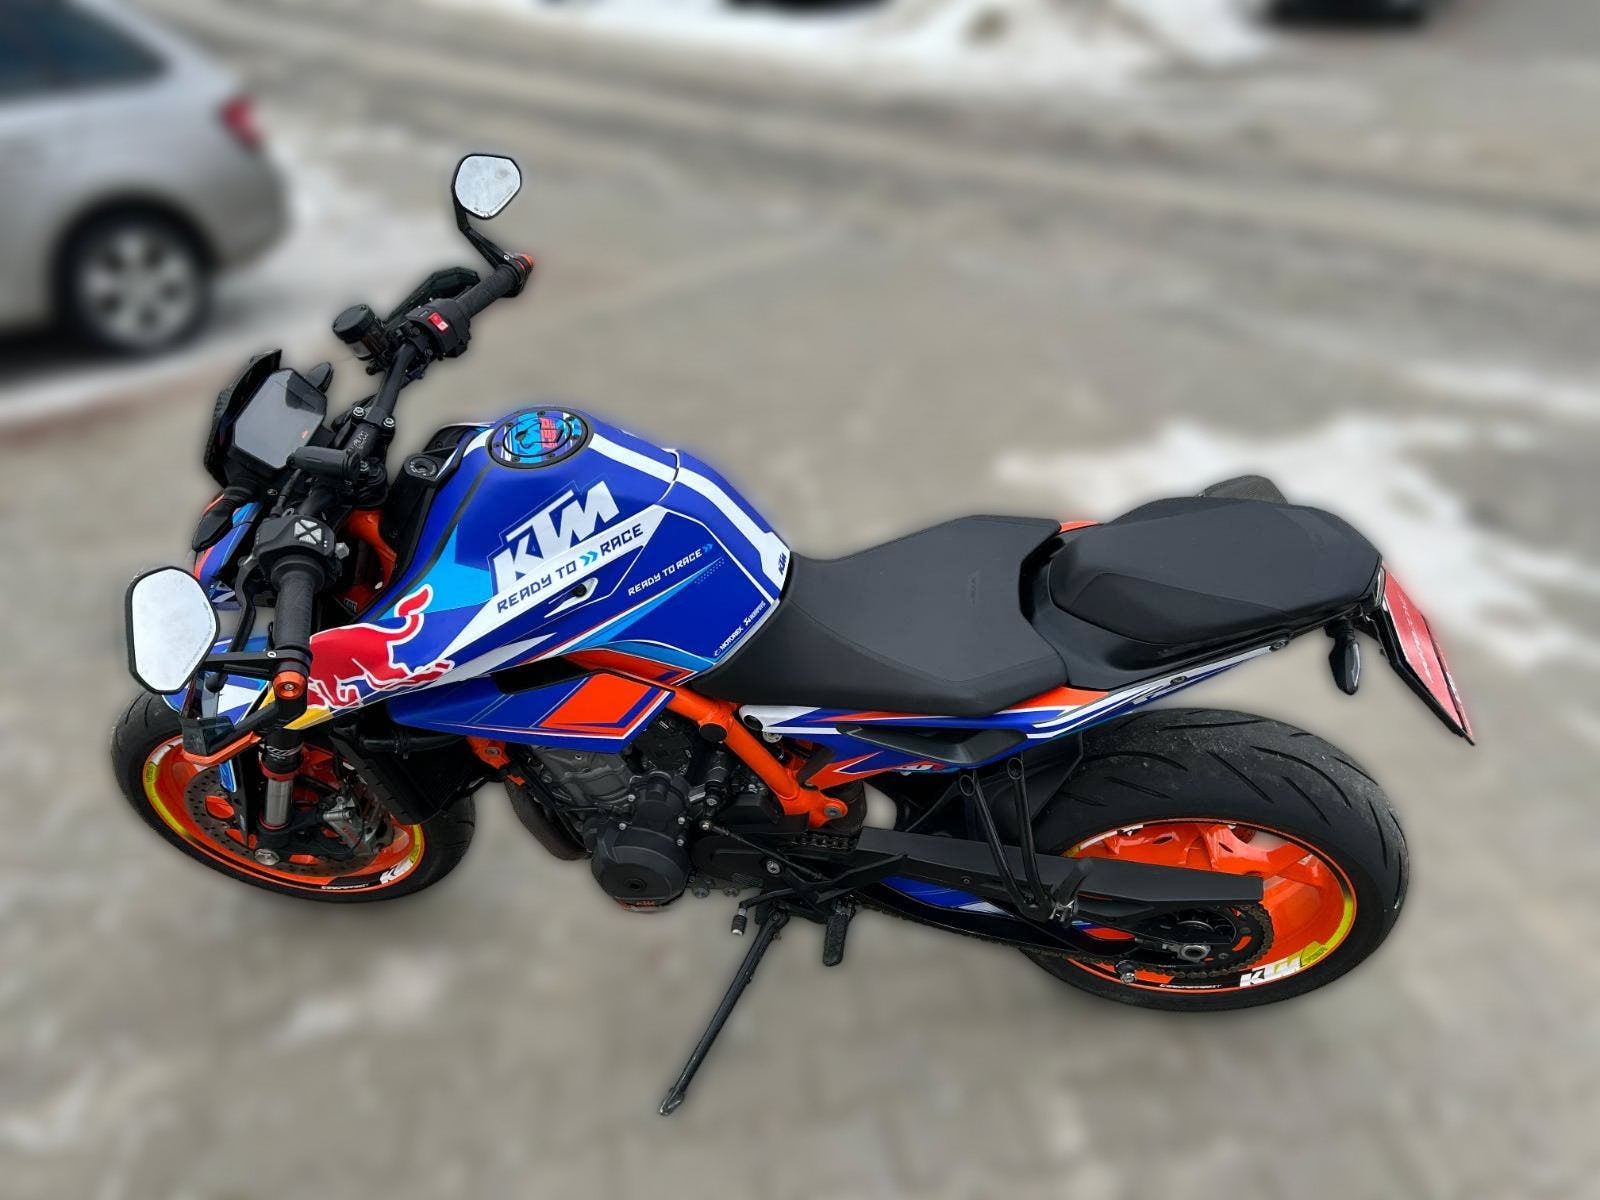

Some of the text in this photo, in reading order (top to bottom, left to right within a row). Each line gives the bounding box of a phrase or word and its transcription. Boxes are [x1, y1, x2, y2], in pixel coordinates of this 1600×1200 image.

[492, 480, 620, 597] KTM
[497, 523, 644, 614] READY TO RACE
[627, 548, 703, 597] READY TO RACE
[719, 625, 744, 650] MOTOREX
[1240, 956, 1301, 987] KTM
